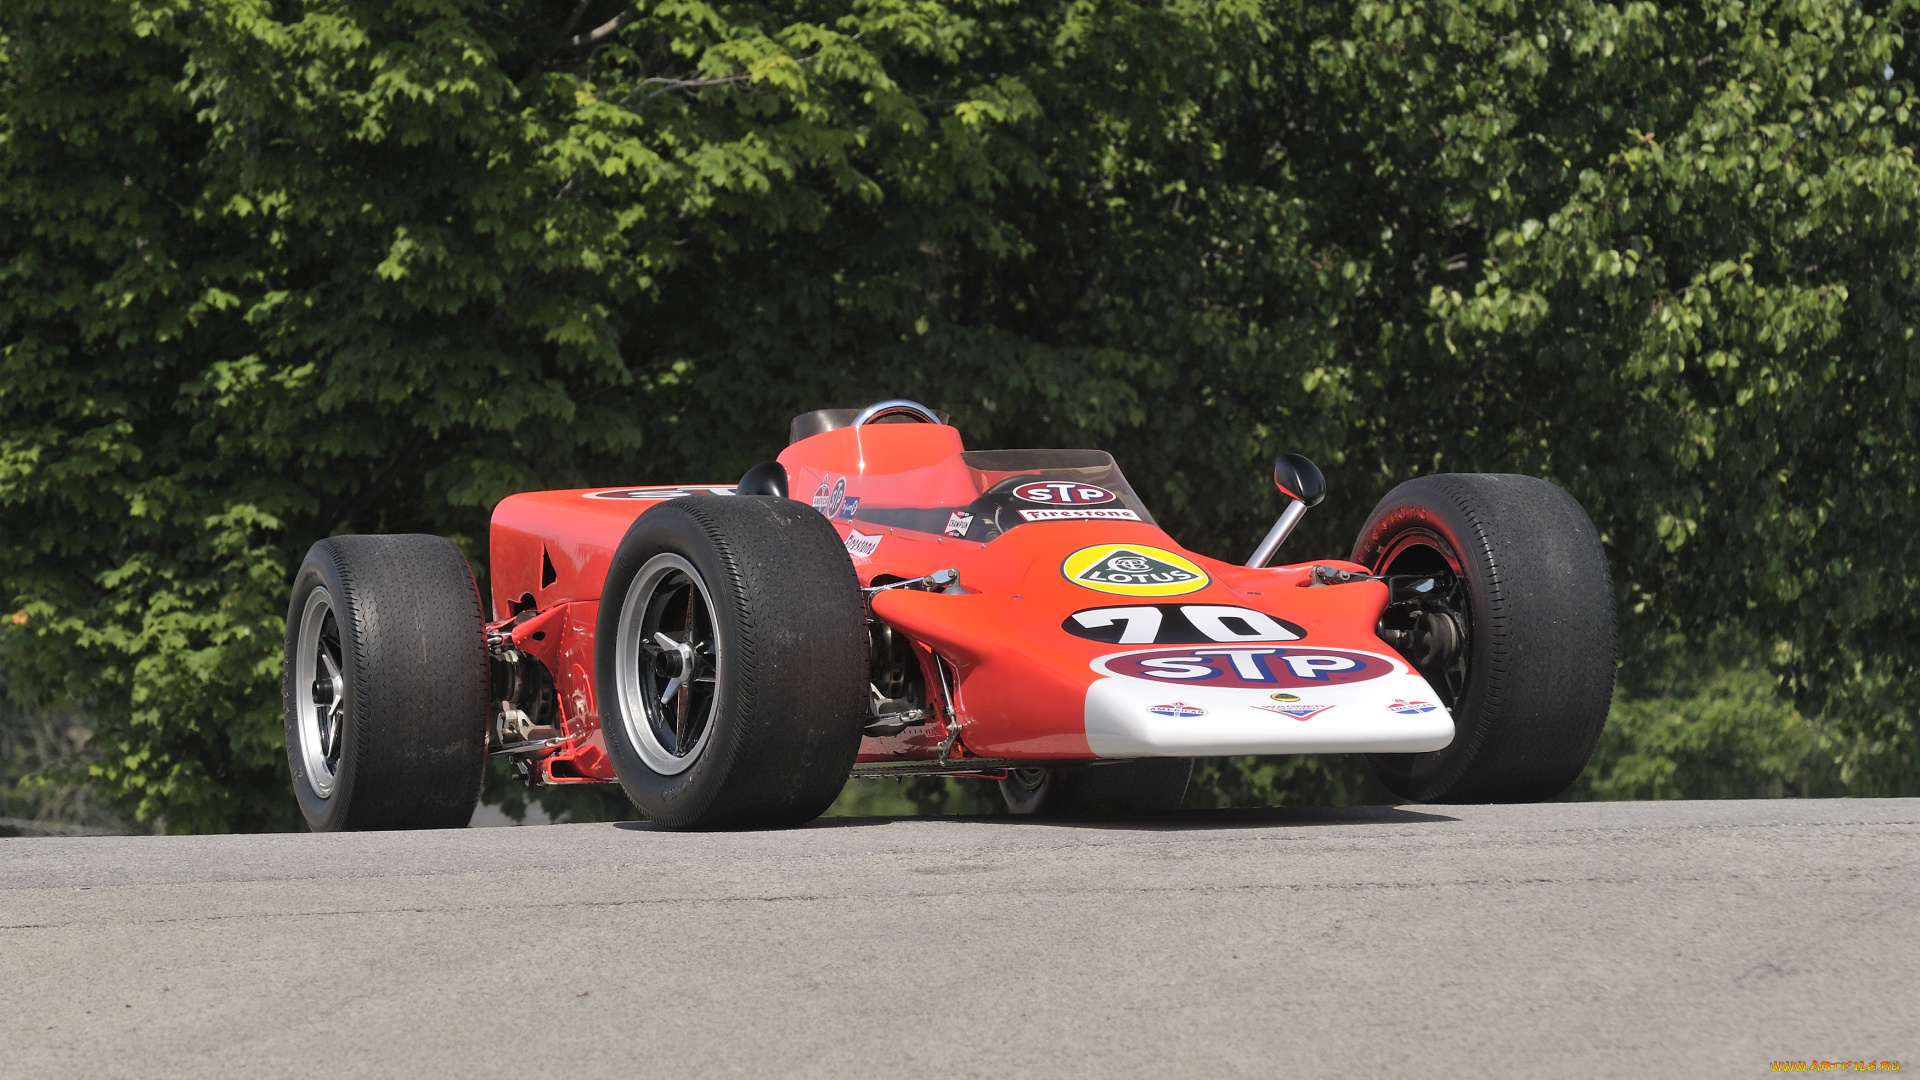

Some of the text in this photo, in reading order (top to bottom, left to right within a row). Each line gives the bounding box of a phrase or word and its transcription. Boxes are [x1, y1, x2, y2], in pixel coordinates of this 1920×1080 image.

[829, 482, 844, 510] STP
[1026, 484, 1105, 502] STP
[1026, 509, 1134, 519] Firestone
[948, 519, 969, 529] CHAMPION
[845, 534, 876, 555] Firestone
[1088, 570, 1193, 584] LOTUS
[1071, 605, 1301, 645] 70
[1138, 649, 1358, 681] STP
[1389, 703, 1435, 712] AMERICAN
